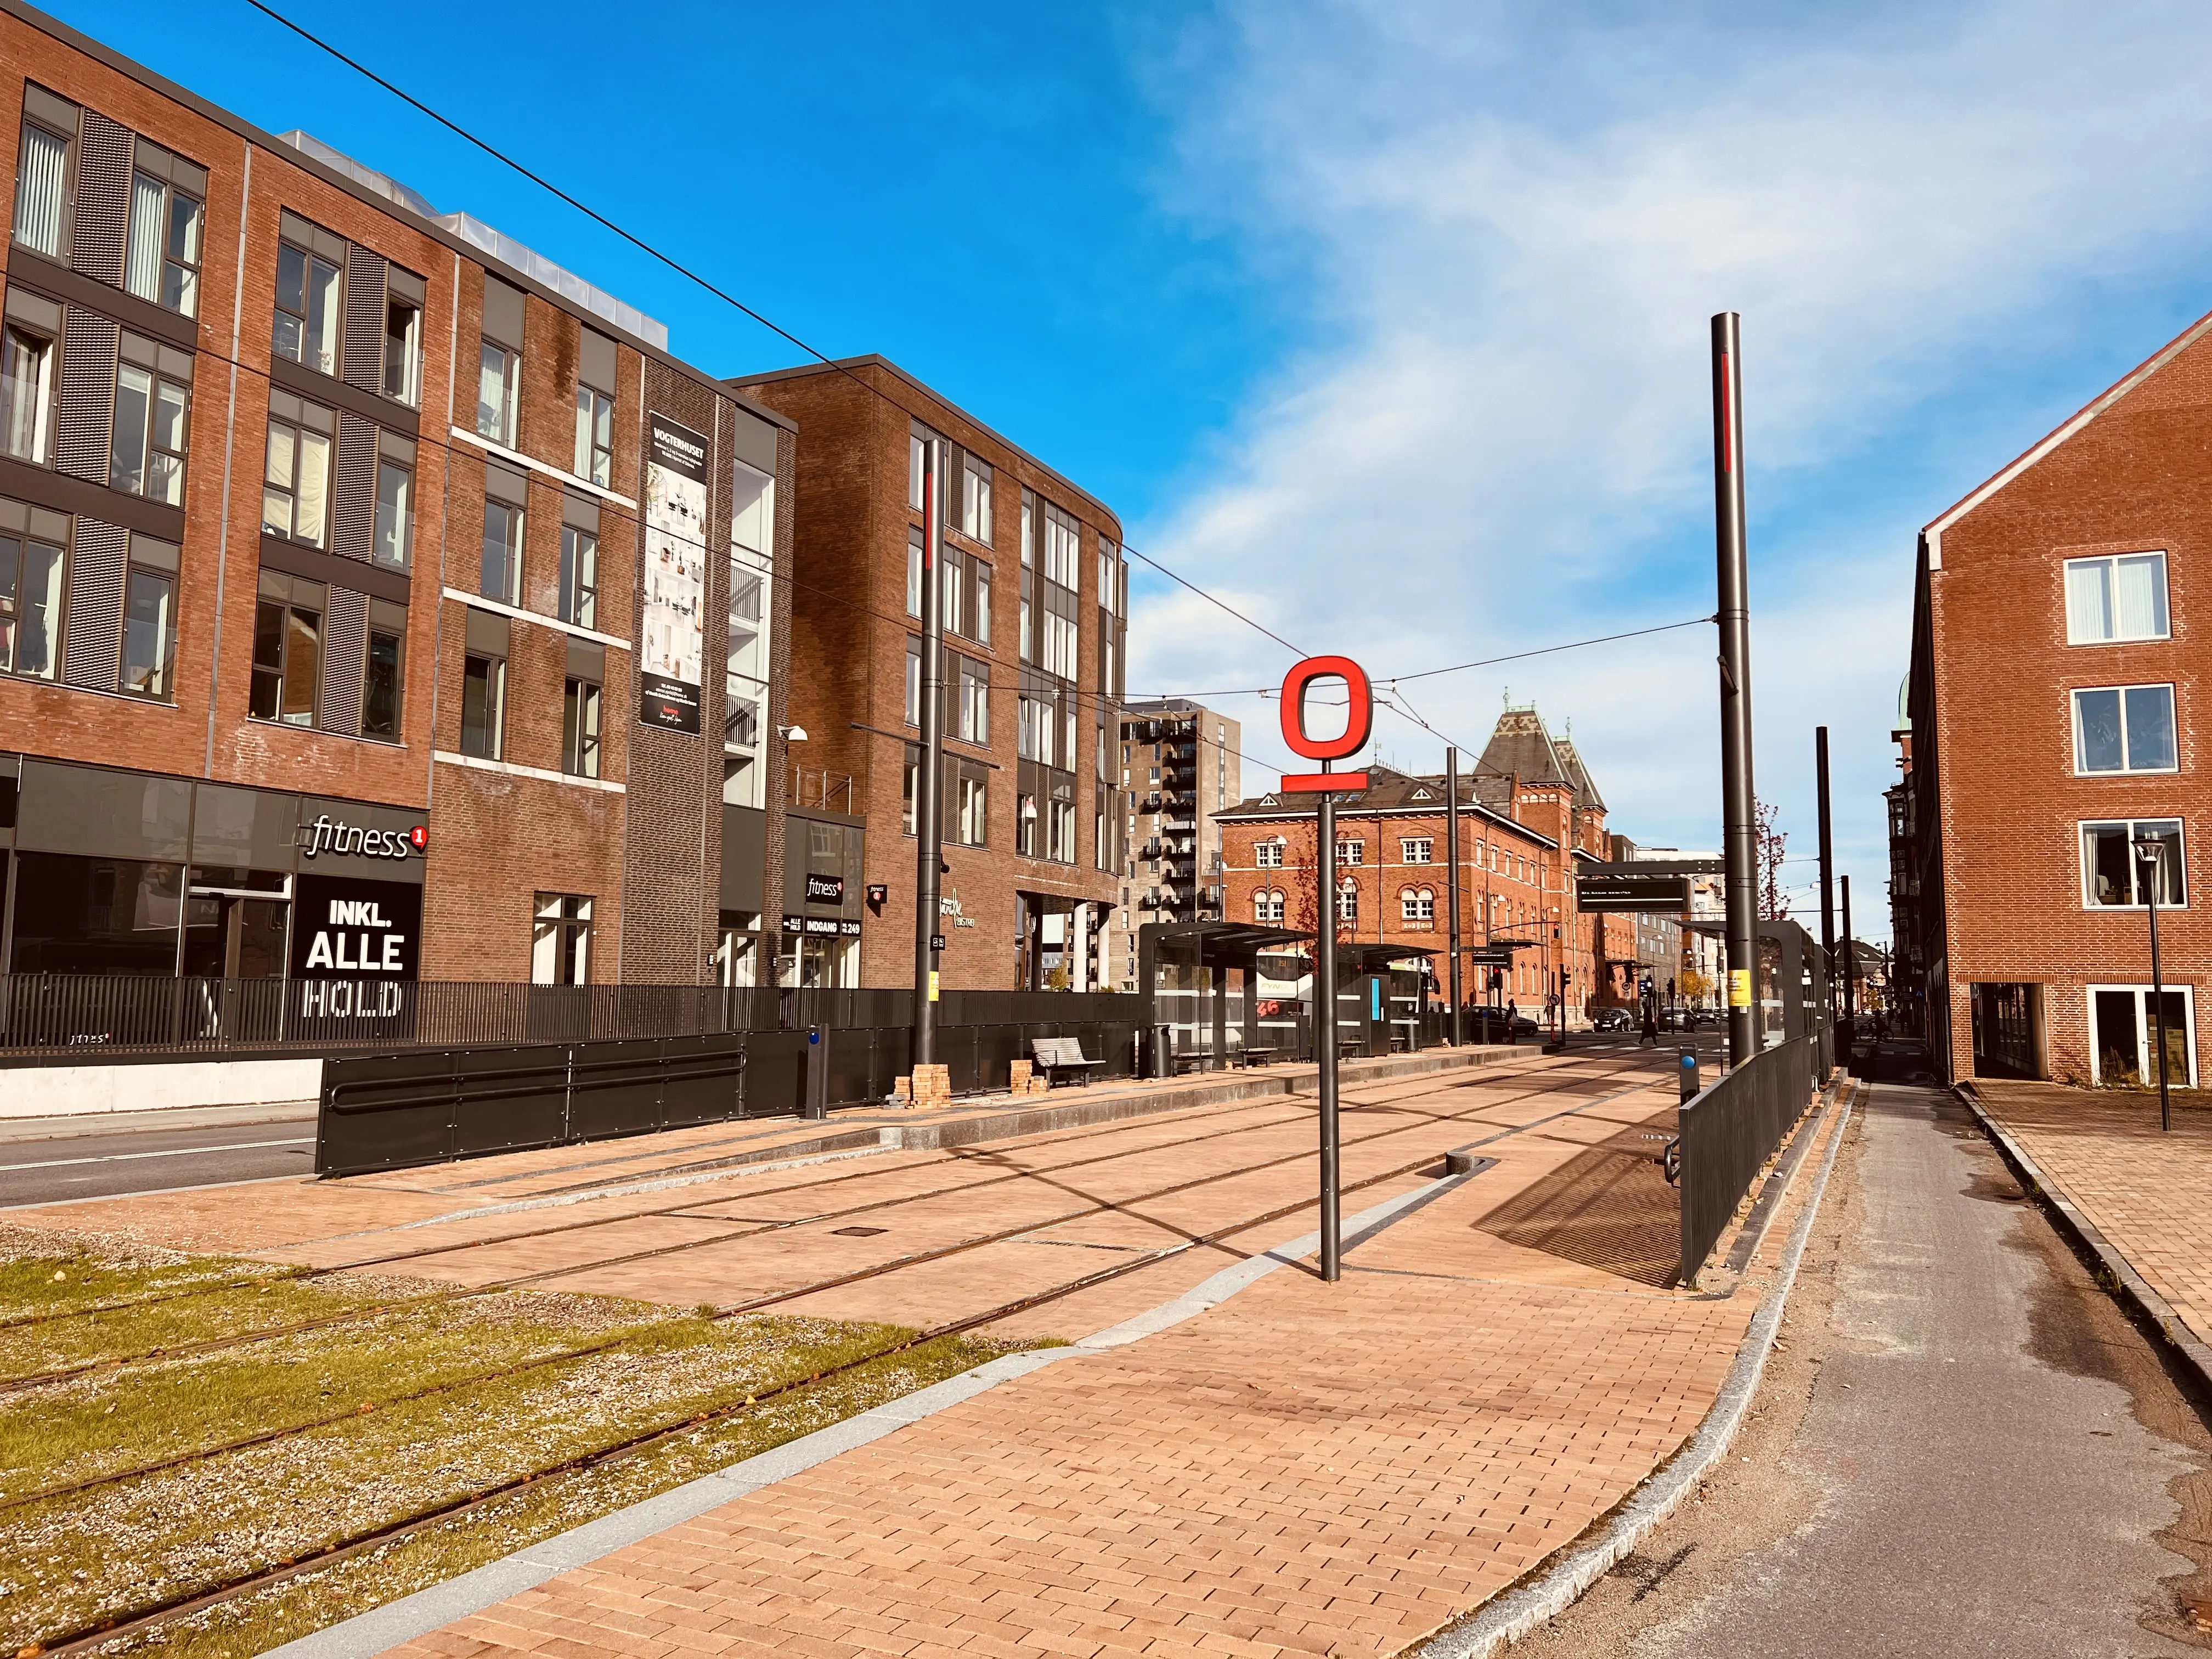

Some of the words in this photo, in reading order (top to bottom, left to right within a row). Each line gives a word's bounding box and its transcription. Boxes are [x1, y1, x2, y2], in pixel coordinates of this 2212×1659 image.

[653, 427, 704, 459] VOGTERHUSET
[663, 704, 679, 715] home
[306, 815, 410, 857] fitness
[807, 878, 837, 896] fitness
[329, 900, 392, 927] INKL.
[957, 917, 975, 927] BISTRO
[806, 920, 837, 933] INDGANG
[848, 923, 860, 934] 249
[306, 931, 405, 970] ALLE
[302, 979, 402, 1018] HOLD
